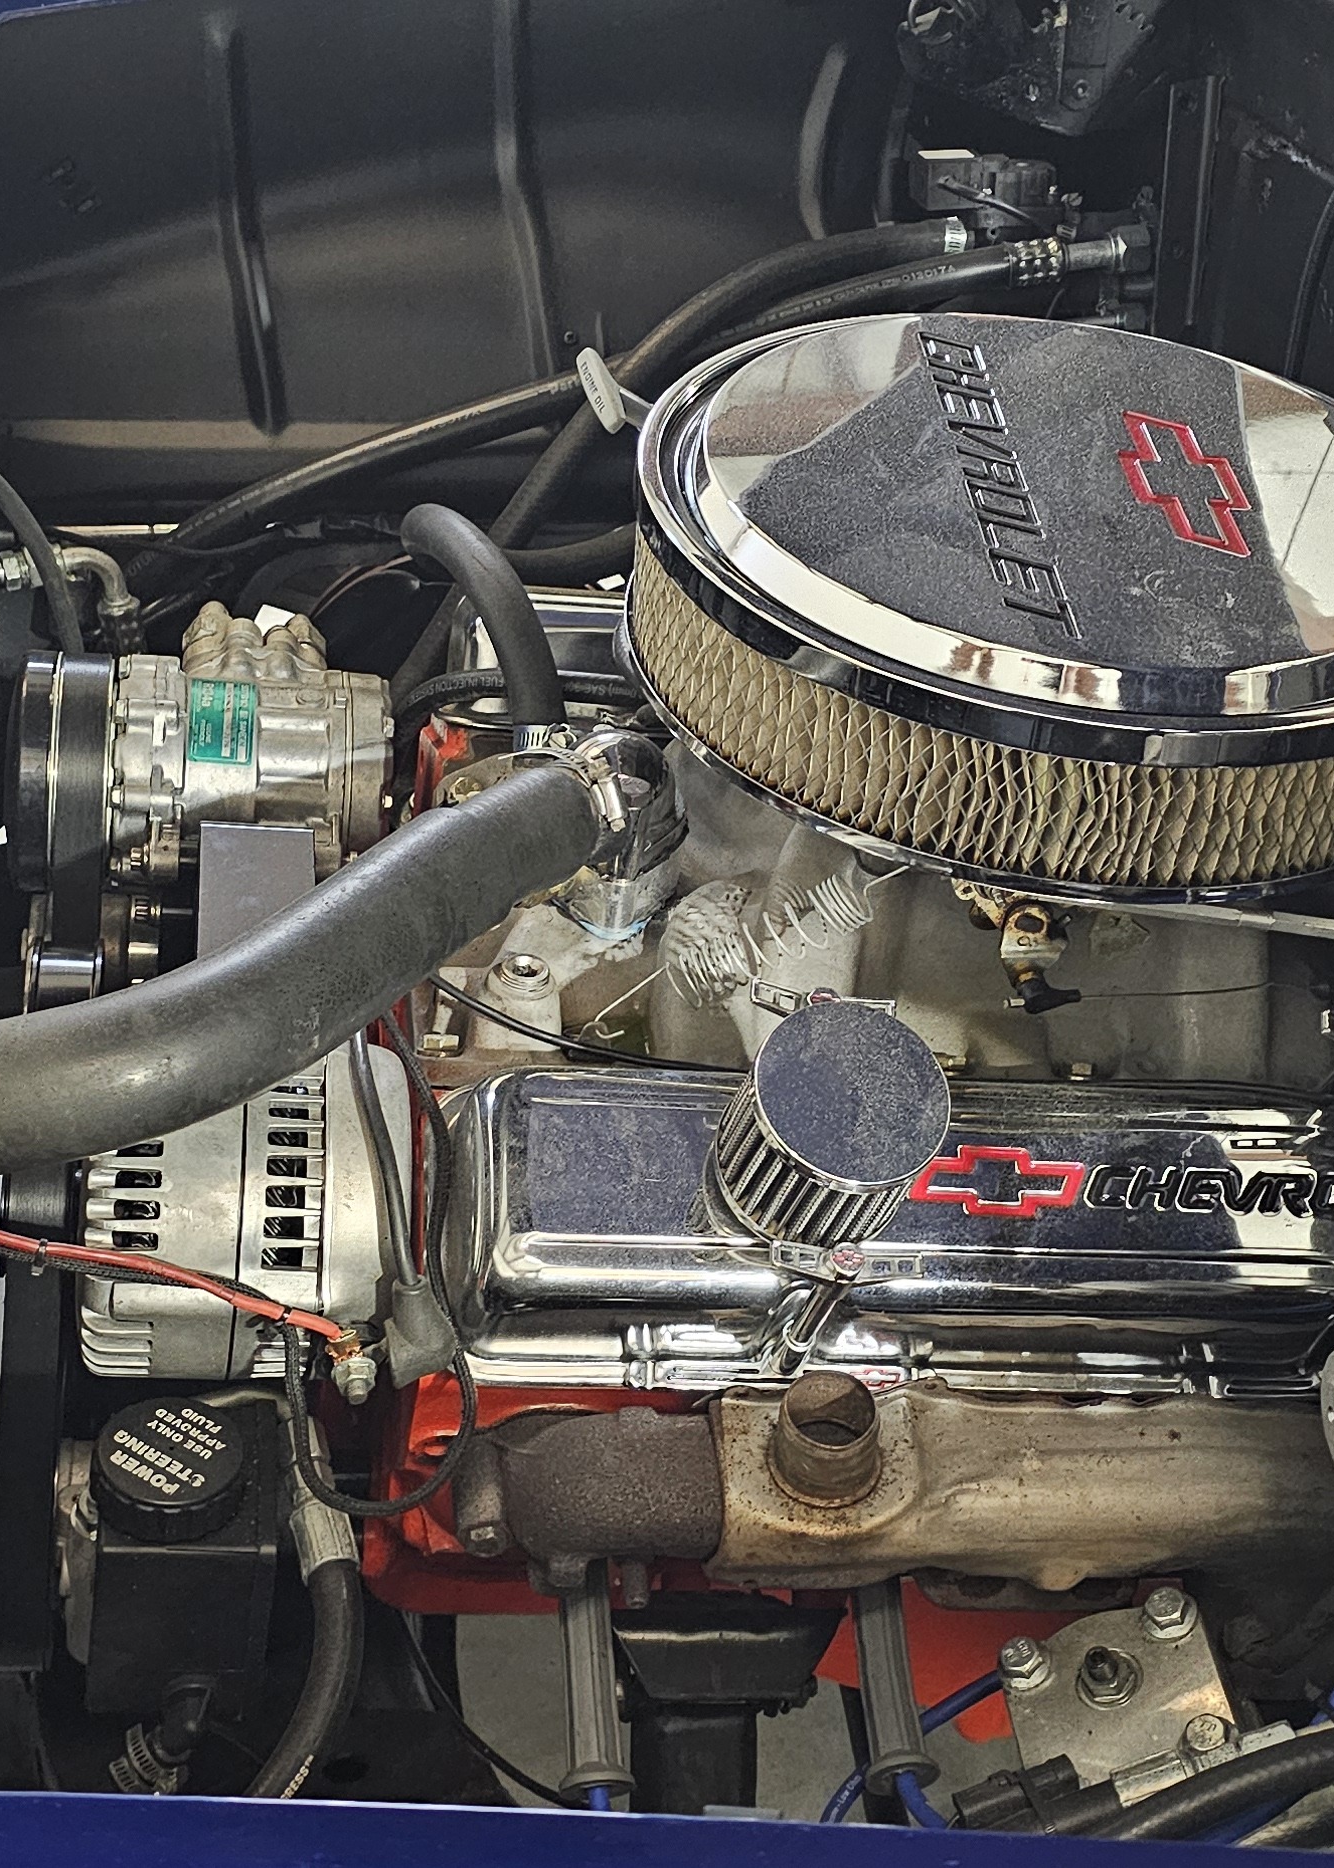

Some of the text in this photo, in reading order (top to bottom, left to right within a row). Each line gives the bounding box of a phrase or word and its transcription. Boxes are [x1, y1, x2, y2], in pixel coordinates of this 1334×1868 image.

[580, 361, 606, 414] ENGINE OIL
[917, 331, 1083, 640] CHEVROLET
[481, 676, 505, 688] FUEL
[147, 1419, 214, 1460] USE ONLY
[155, 1408, 227, 1451] APPROVED
[181, 1408, 223, 1434] FLUID
[109, 1449, 181, 1496] POWER
[113, 1429, 206, 1488] STEERING
